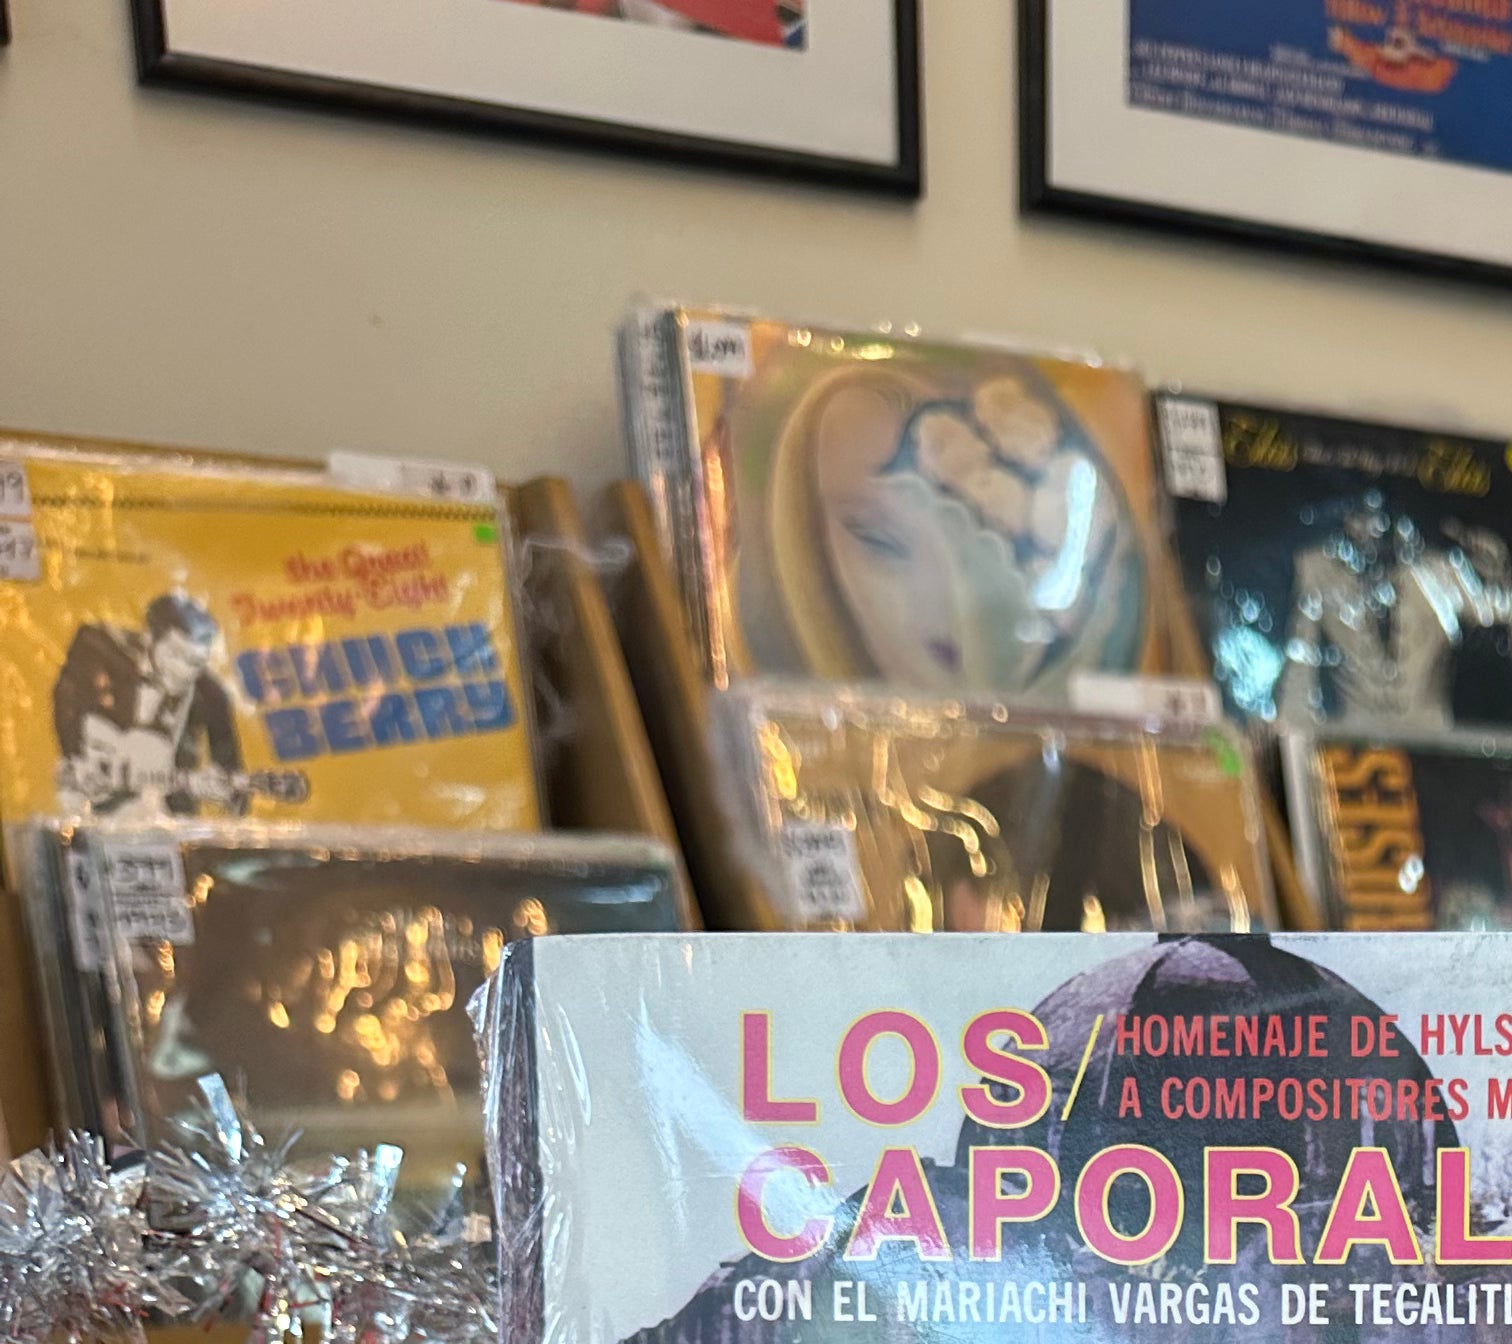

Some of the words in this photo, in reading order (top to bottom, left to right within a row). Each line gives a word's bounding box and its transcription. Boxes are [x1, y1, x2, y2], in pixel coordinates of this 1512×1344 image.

[235, 622, 501, 705] CHUCK
[264, 681, 516, 765] BERRY
[1116, 1014, 1329, 1058] HOMENAJE
[1350, 1014, 1400, 1058] DE
[1118, 1076, 1143, 1119] A
[1160, 1076, 1470, 1122] COMPOSITORES
[733, 1278, 812, 1322] CON
[832, 1280, 877, 1323] EL
[896, 1280, 1087, 1324] MARIACHI
[1108, 1280, 1261, 1326] VARGAS
[1280, 1283, 1330, 1326] DE
